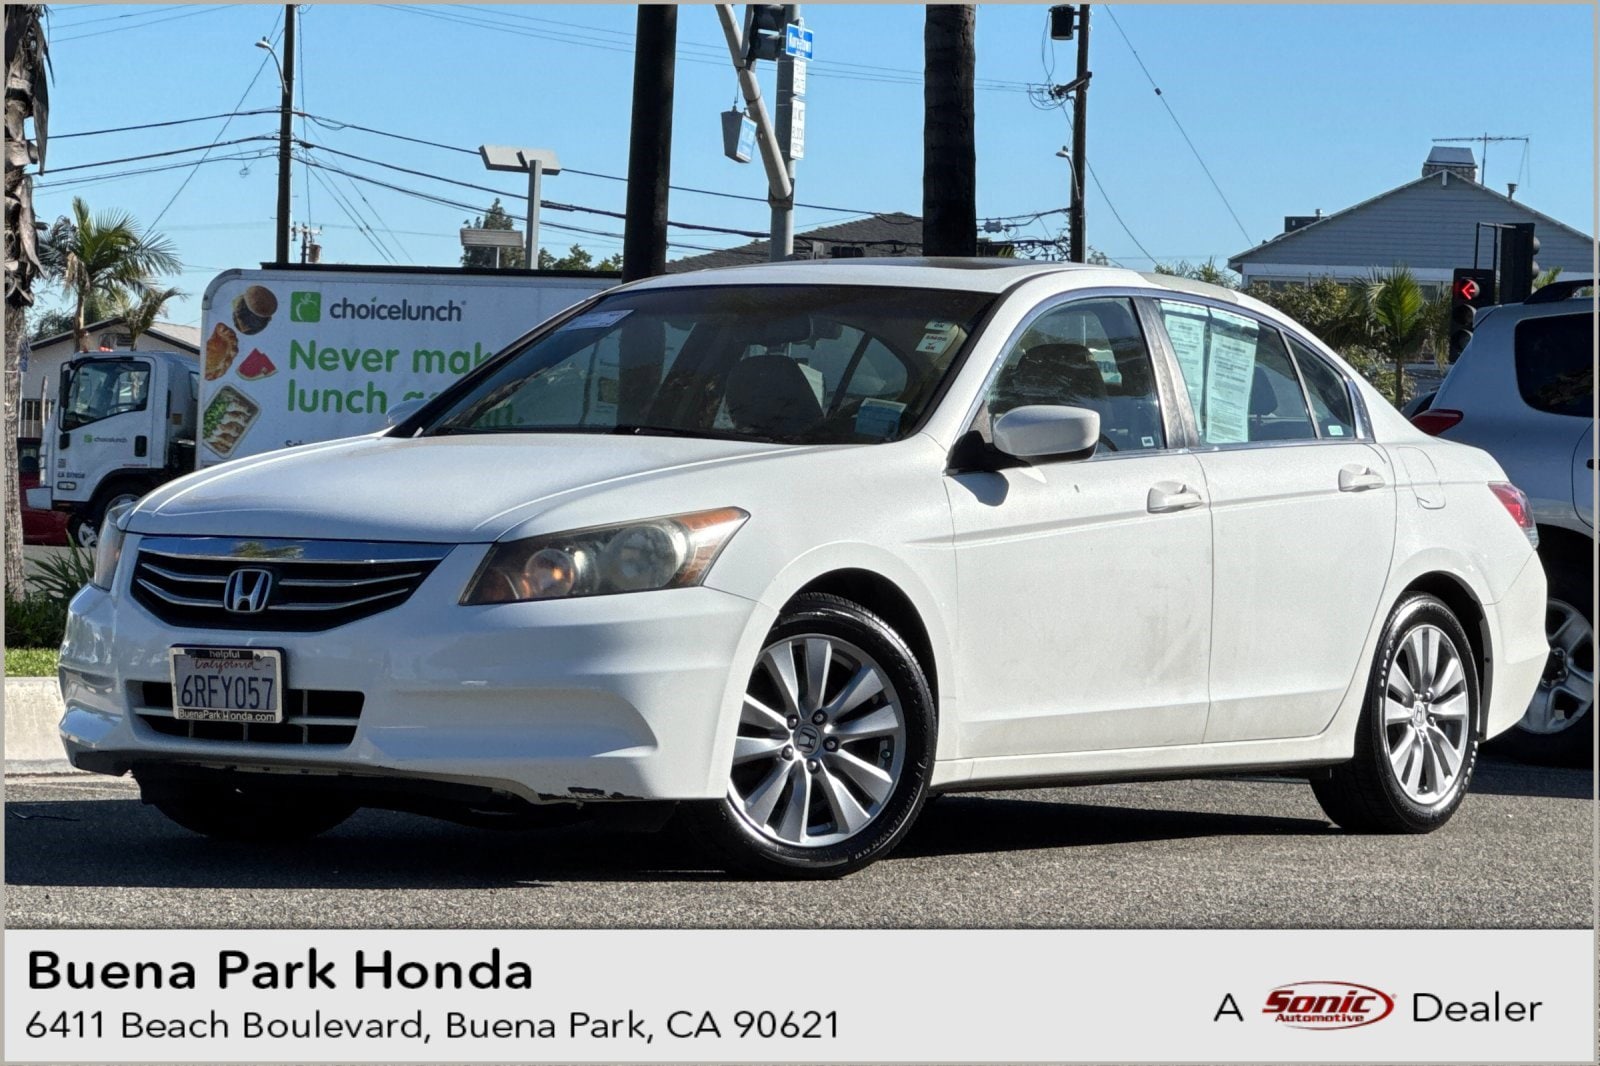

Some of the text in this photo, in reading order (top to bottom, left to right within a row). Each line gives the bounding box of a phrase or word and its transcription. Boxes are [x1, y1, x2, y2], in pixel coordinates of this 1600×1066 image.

[329, 296, 463, 322] choicelunch
[290, 339, 493, 374] Never mak
[287, 379, 387, 414] lunch
[195, 658, 257, 674] California
[209, 650, 240, 659] helpful
[181, 675, 274, 709] 6RFY057
